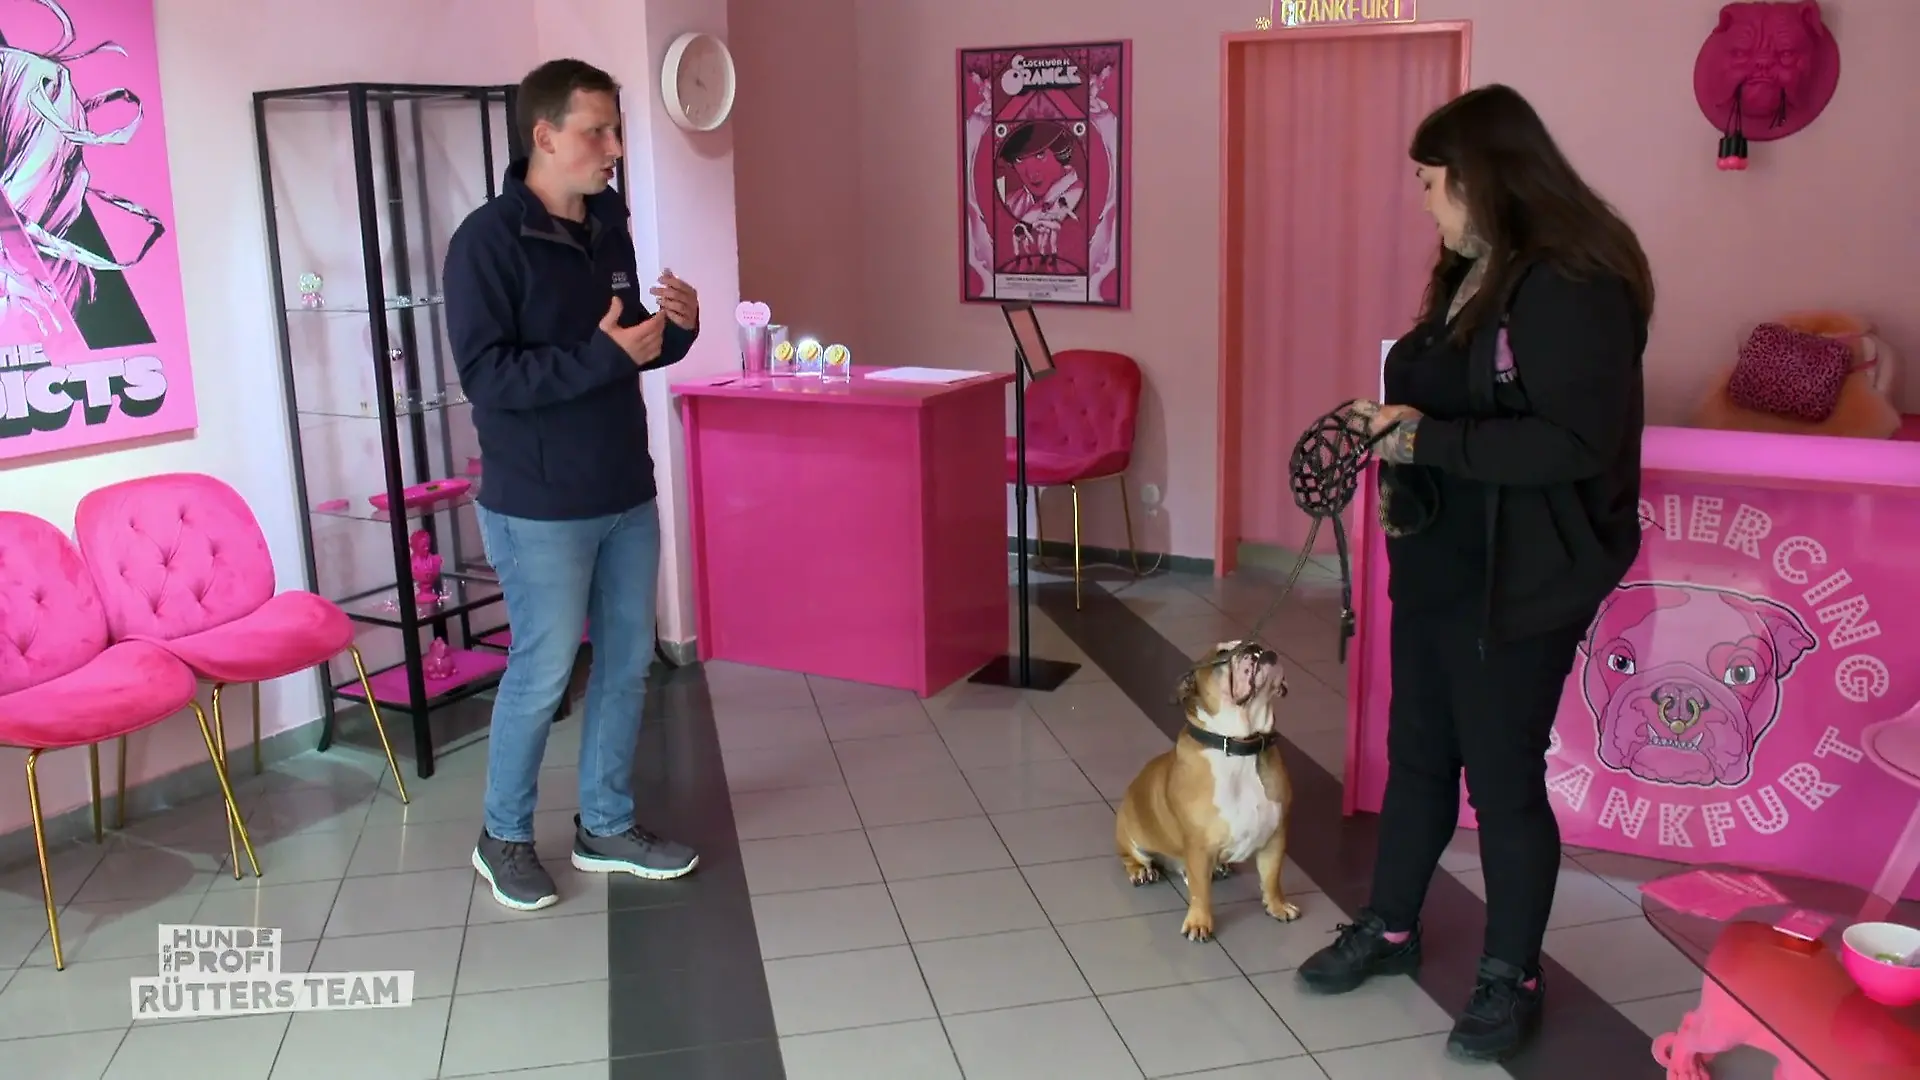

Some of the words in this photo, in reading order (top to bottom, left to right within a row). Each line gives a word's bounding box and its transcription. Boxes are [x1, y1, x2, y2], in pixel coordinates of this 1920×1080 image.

[1281, 0, 1401, 25] FRANKFURT
[1012, 55, 1070, 70] CLOCKWORK
[1001, 66, 1082, 96] ORANGE
[0, 355, 168, 424] ICTS
